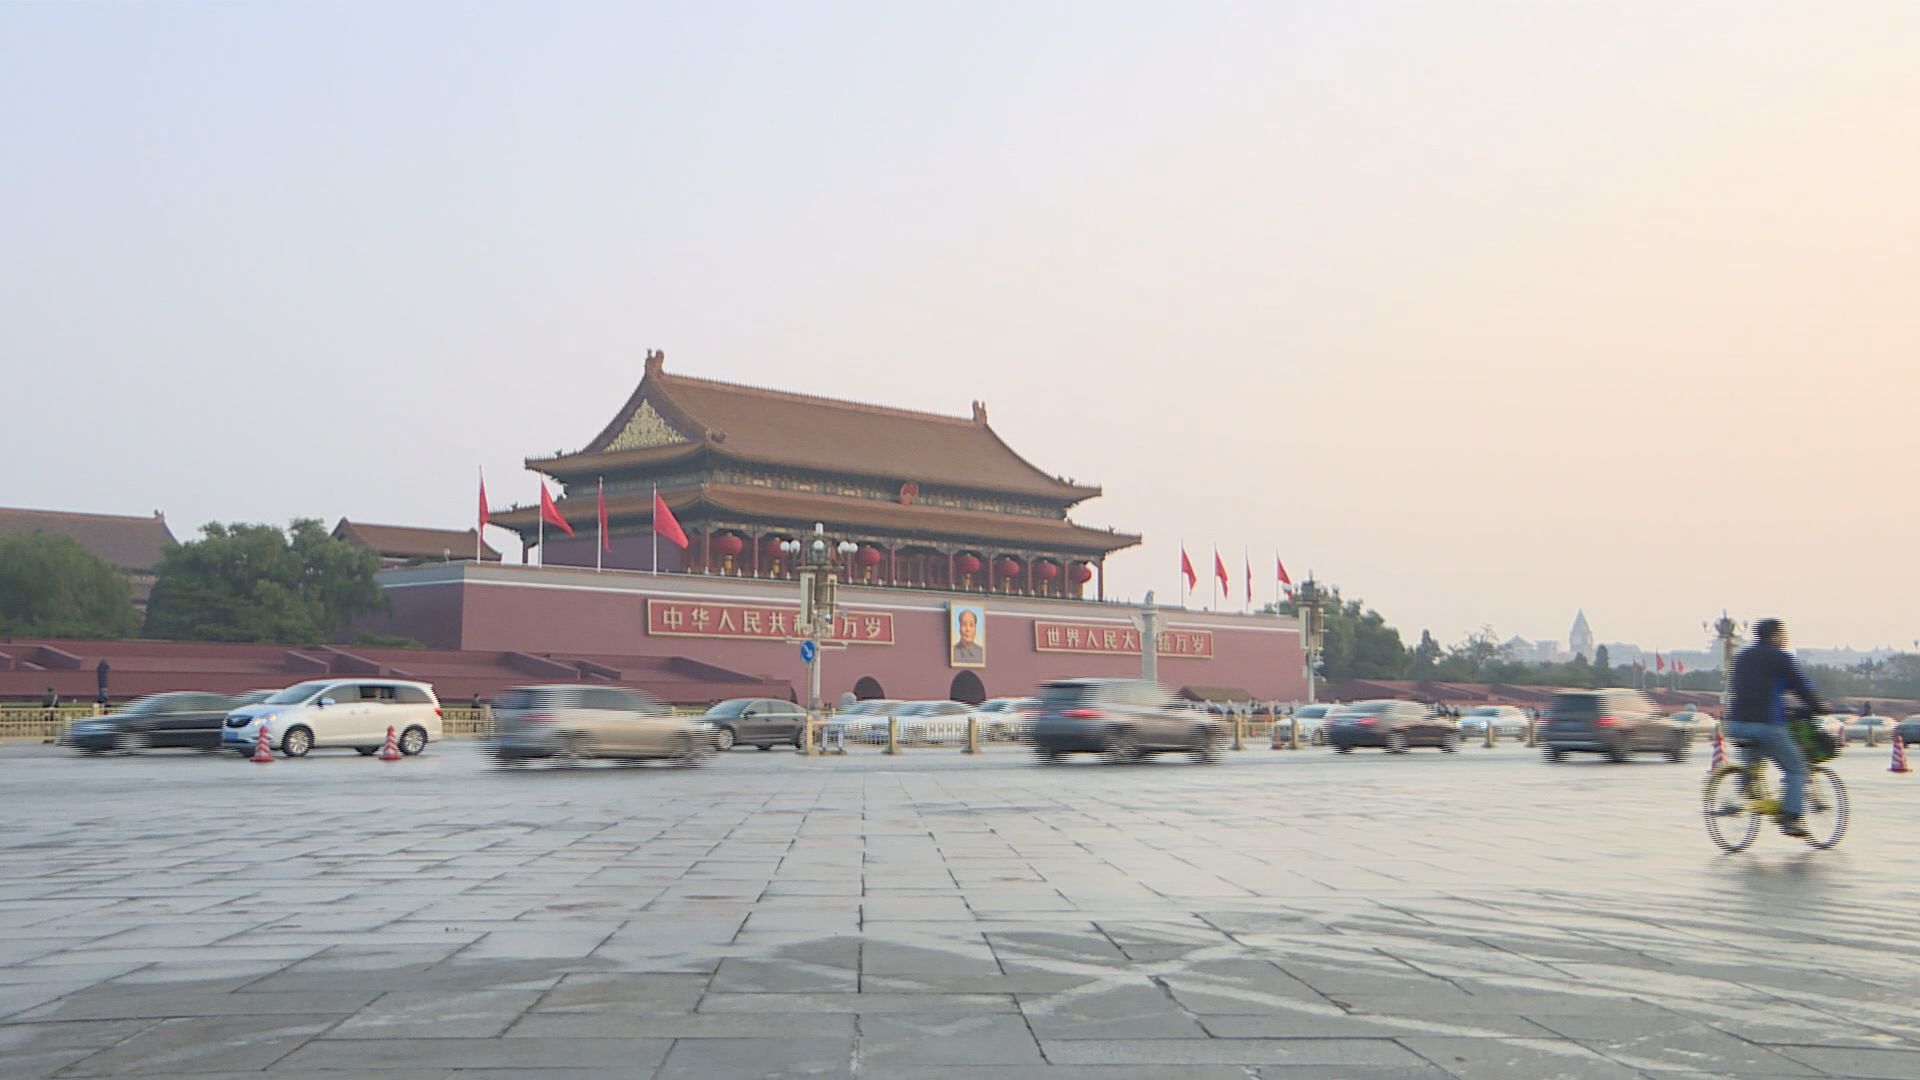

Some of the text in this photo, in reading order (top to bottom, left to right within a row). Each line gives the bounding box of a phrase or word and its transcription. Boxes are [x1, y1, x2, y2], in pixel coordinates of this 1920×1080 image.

[663, 606, 881, 638] 中华人民共万岁
[1046, 626, 1204, 653] 世界人民大结万岁
